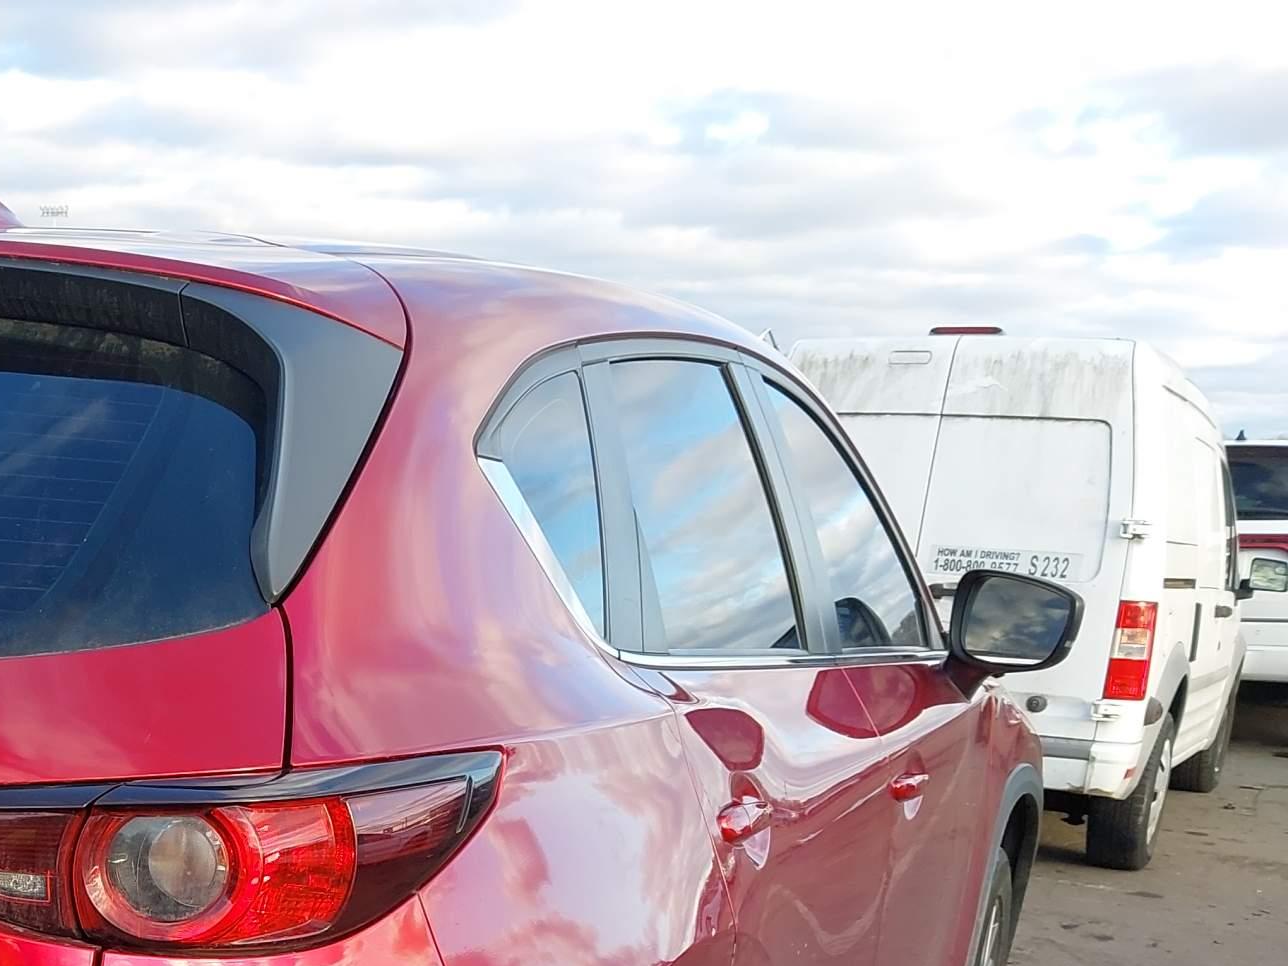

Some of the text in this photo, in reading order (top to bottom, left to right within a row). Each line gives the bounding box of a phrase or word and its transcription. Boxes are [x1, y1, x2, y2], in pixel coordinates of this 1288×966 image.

[937, 548, 958, 557] HOW
[959, 549, 973, 558] AM
[979, 550, 1022, 561] DRIVING?
[1028, 554, 1070, 578] S 232
